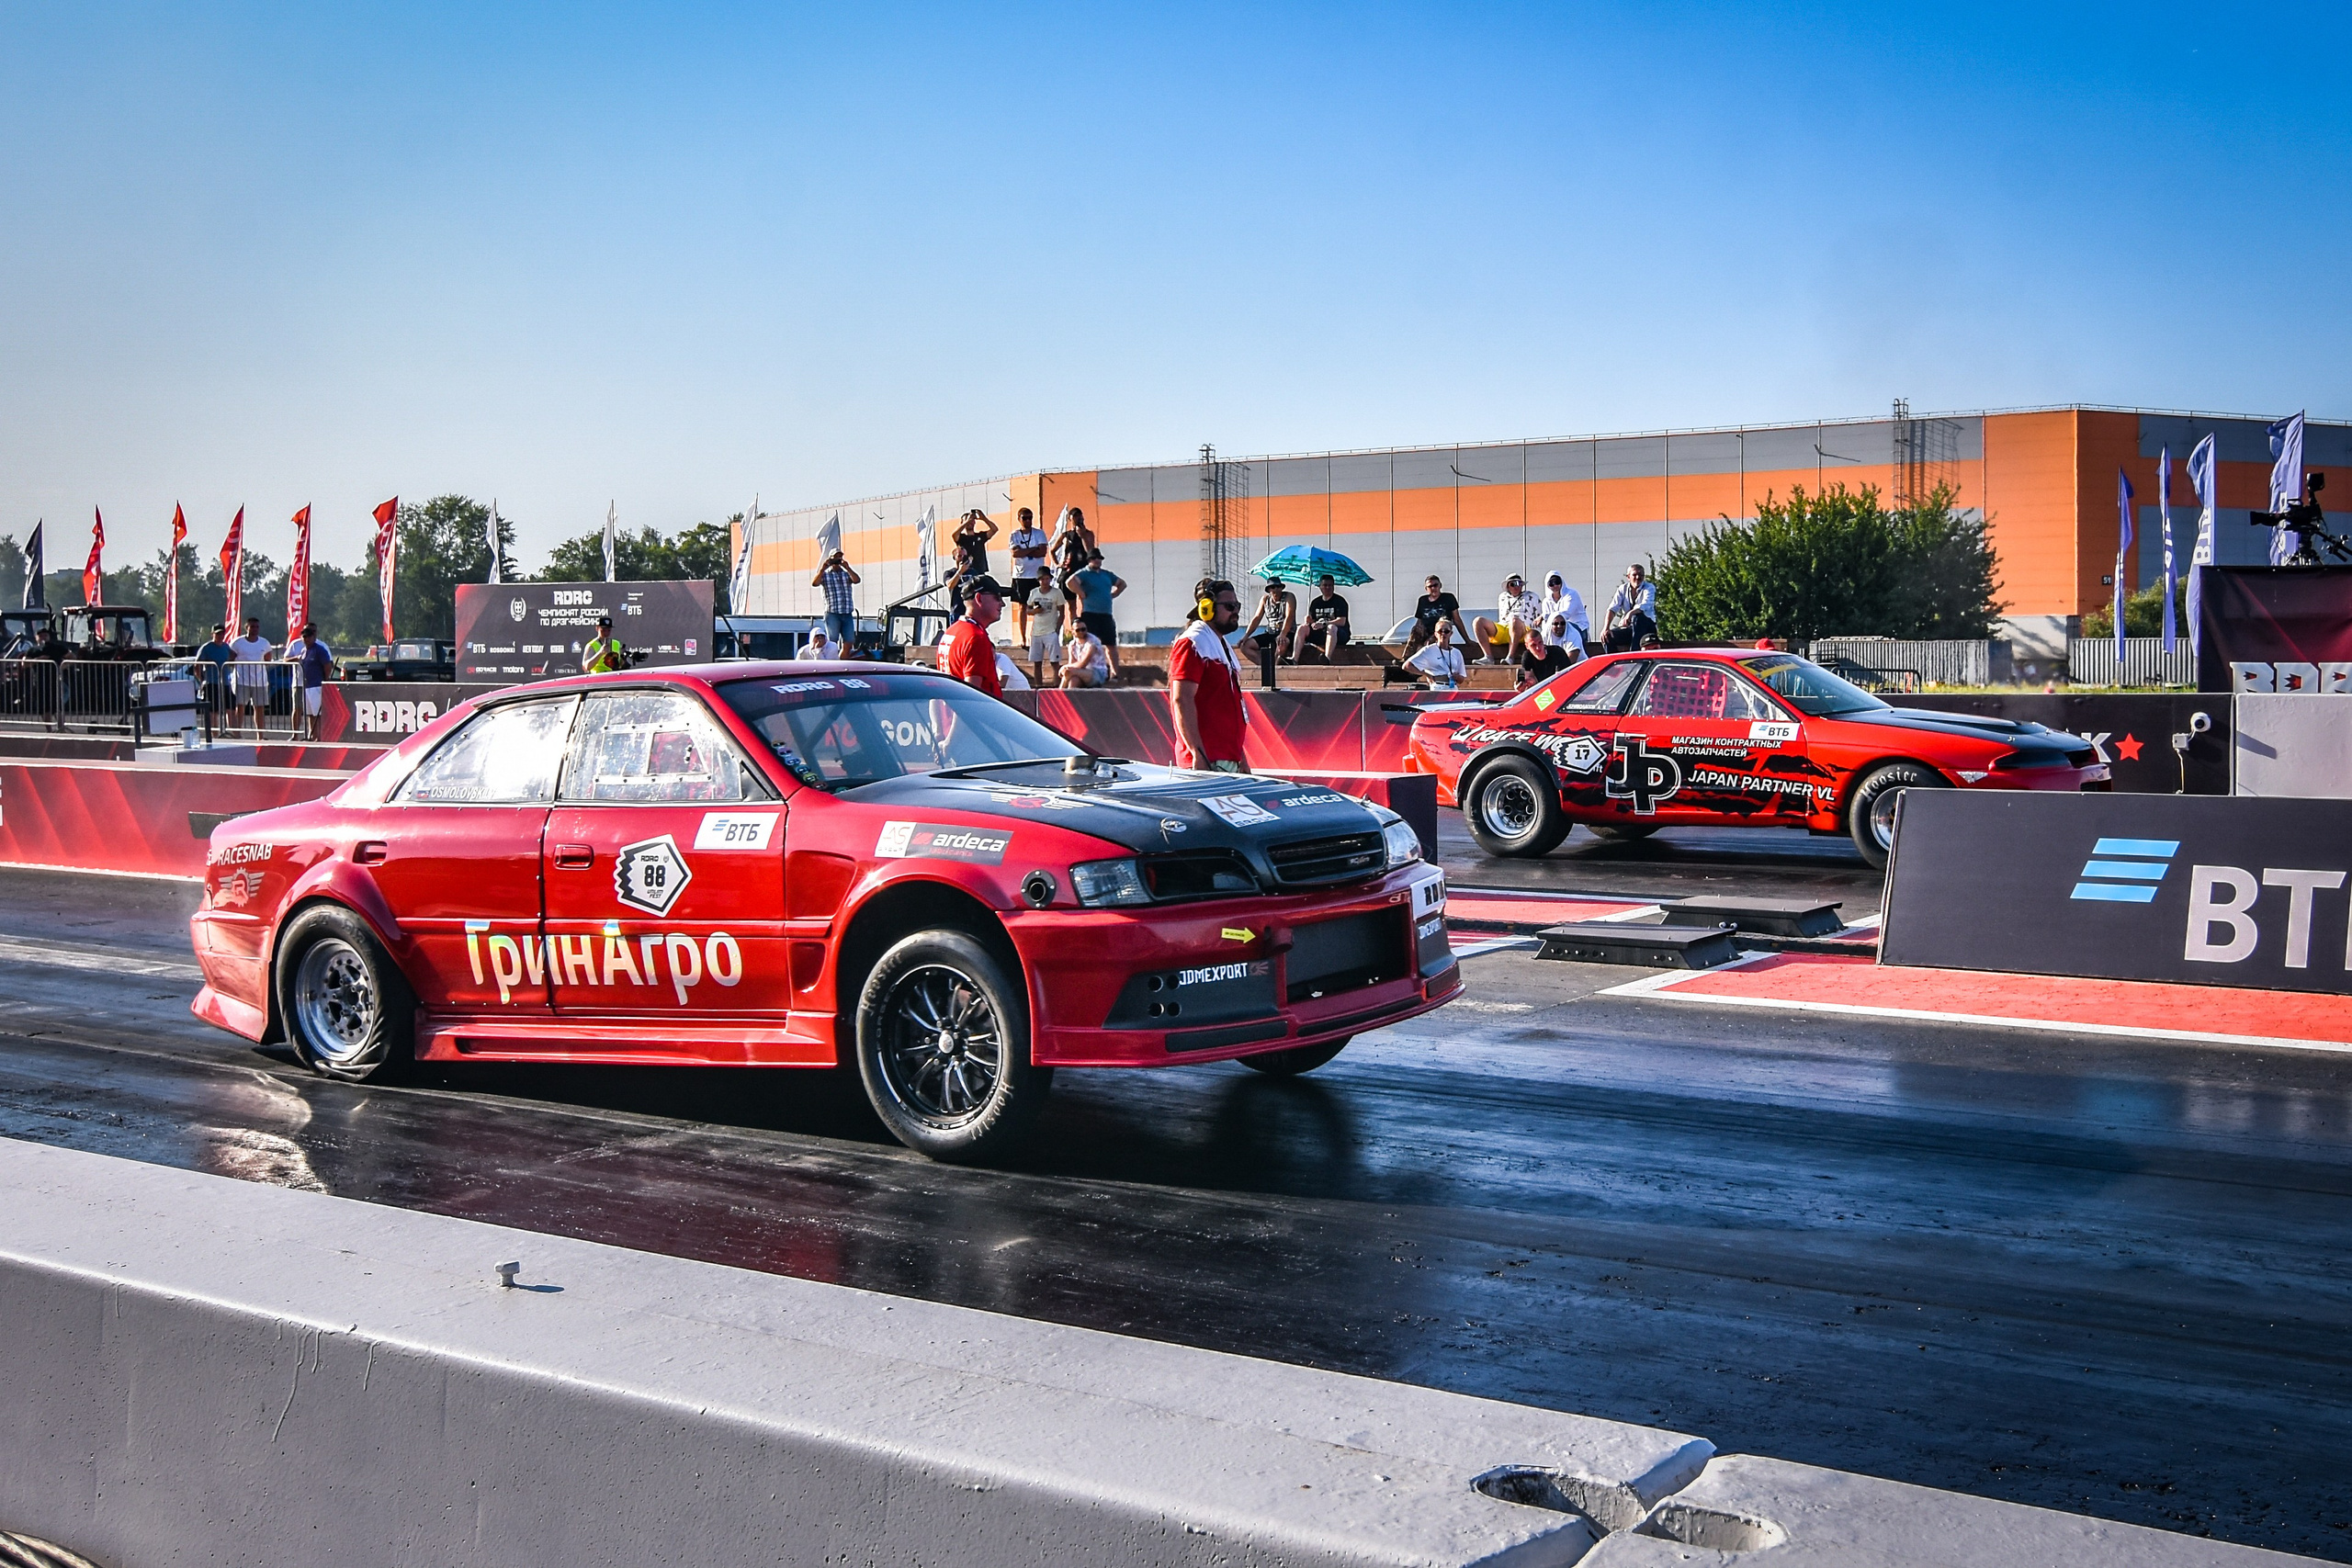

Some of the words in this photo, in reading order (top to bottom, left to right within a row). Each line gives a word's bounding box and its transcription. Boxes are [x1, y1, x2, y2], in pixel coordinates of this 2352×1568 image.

[553, 591, 593, 605] RDRC
[537, 608, 579, 617] ЧЕМПИОНАТ
[628, 605, 642, 615] ВТБ
[540, 618, 549, 626] ПО
[472, 643, 486, 654] ВТБ
[771, 681, 835, 694] RDRC
[839, 678, 871, 689] 88
[355, 701, 437, 732] RDRC
[1768, 726, 1791, 738] ВТБ
[1671, 736, 1713, 746] МАГАЗИН
[1714, 738, 1782, 749] КОНТРАКТНЫХ
[1575, 749, 1590, 761] 17
[1670, 746, 1747, 758] АВТОЗАПЧАСТЕЙ
[1688, 770, 1739, 788] JAPAN
[1740, 776, 1815, 797] PARTNER
[1816, 786, 1836, 801] VL
[1860, 767, 1917, 802] Hoosier
[1282, 794, 1343, 807] ardeca
[725, 824, 761, 842] ВТБ
[933, 832, 1007, 852] ardeca
[218, 842, 273, 866] RACESNAB
[644, 864, 665, 887] 88
[2184, 864, 2352, 972] ВТ
[1179, 963, 1248, 986] JDMEXPORT
